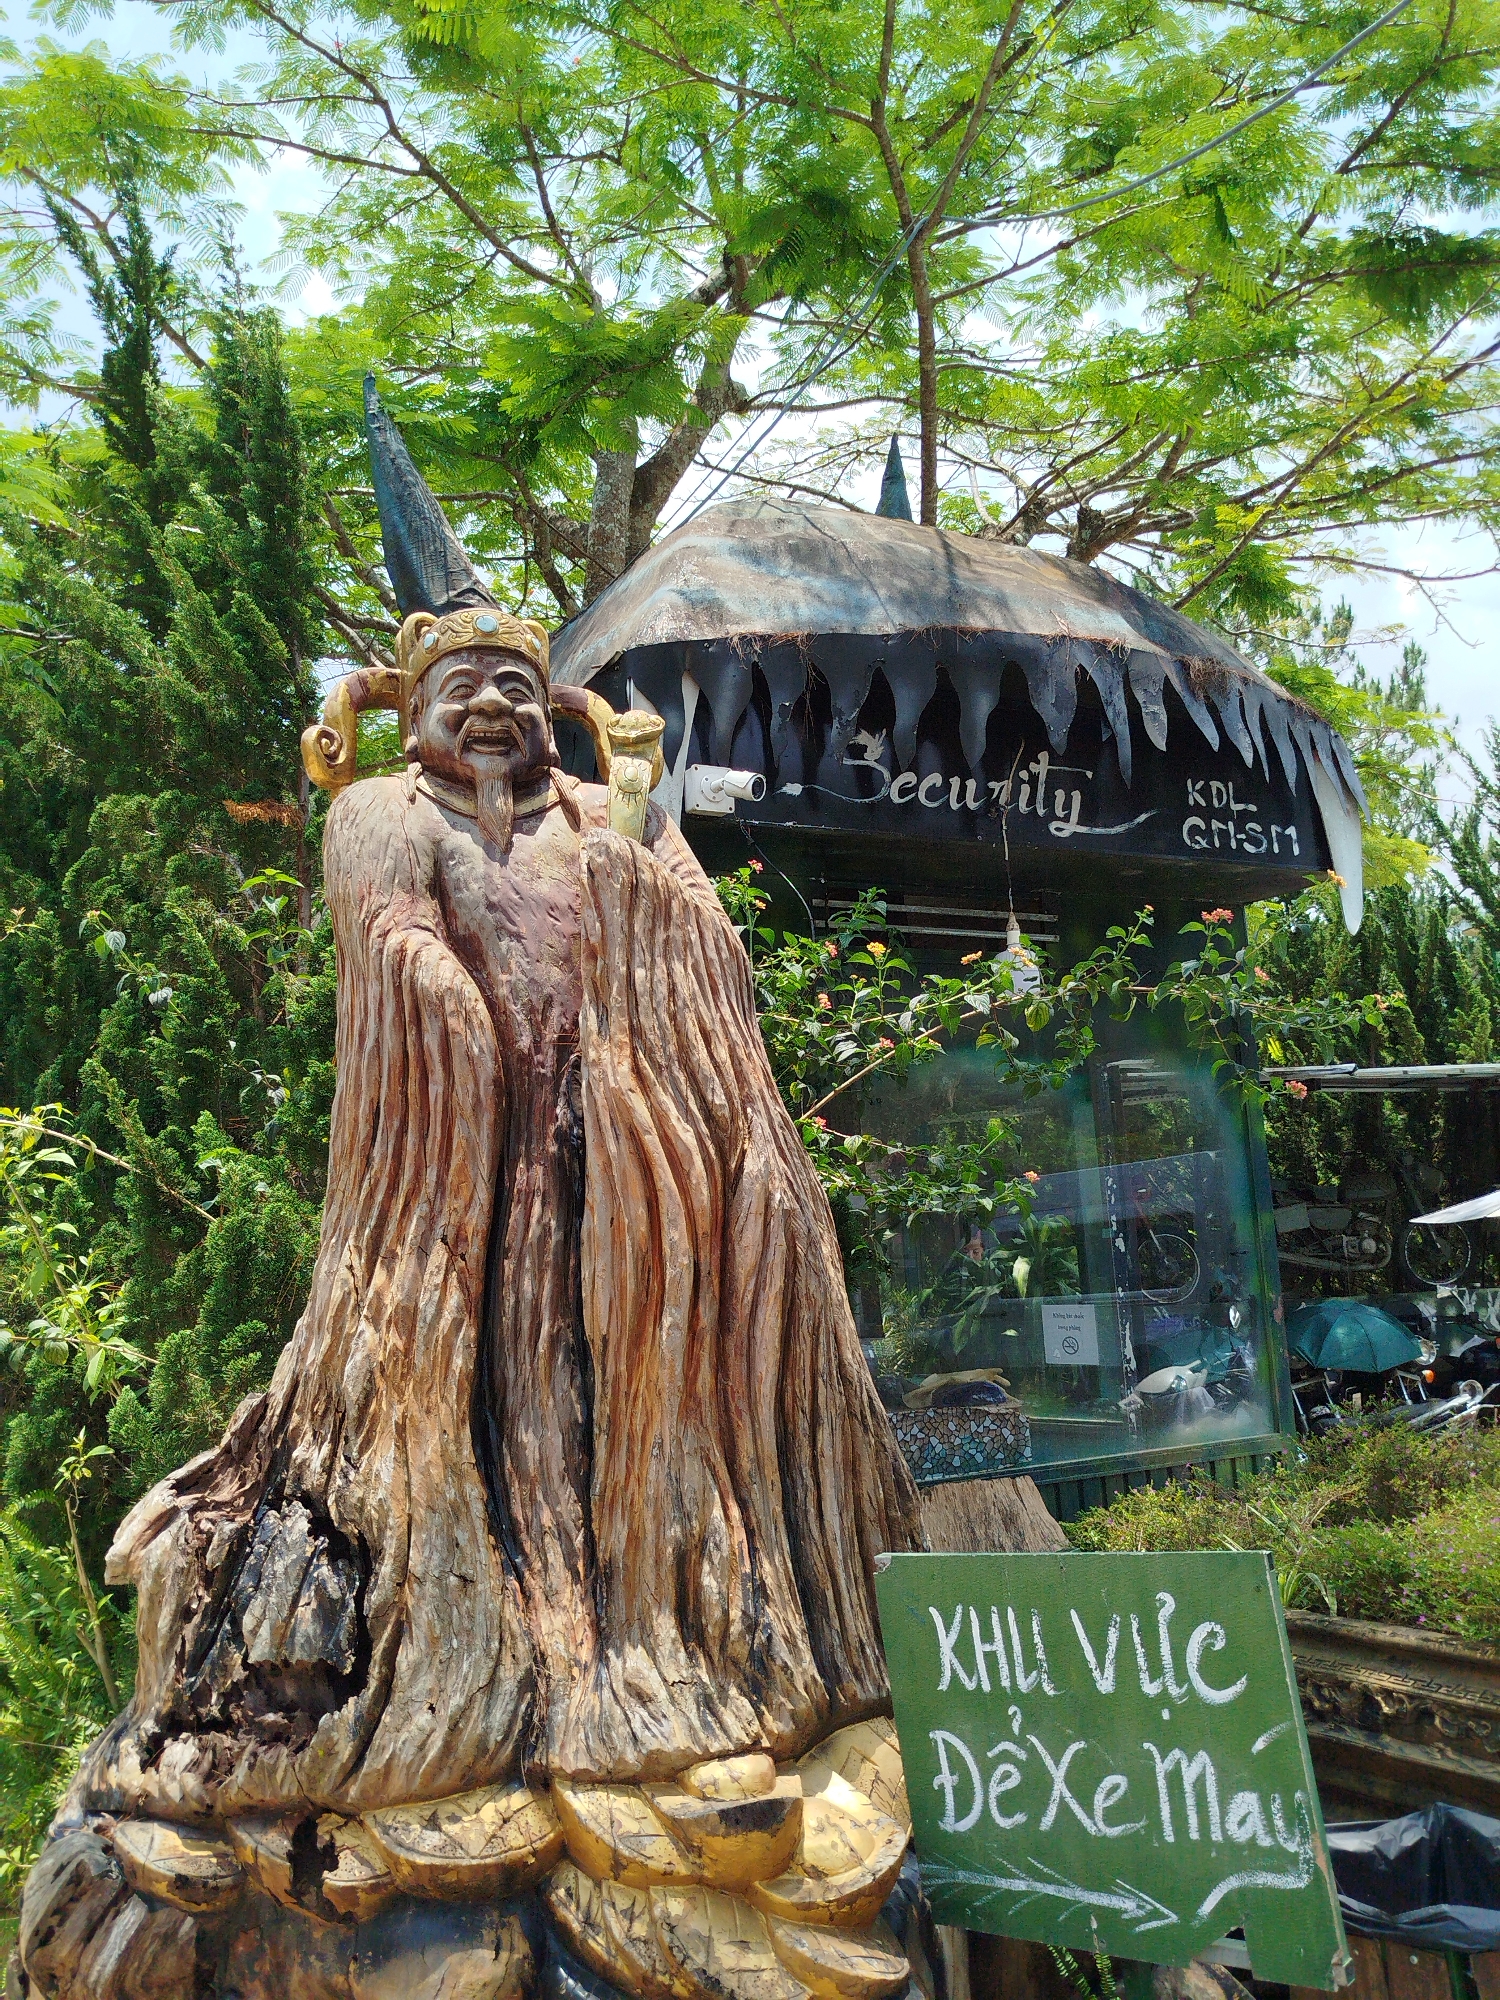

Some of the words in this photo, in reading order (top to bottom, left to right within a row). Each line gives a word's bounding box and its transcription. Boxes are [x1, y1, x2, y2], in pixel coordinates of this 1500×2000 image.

[775, 730, 1157, 837] Security
[1186, 778, 1258, 813] KDL
[929, 1603, 1066, 1696] KHU
